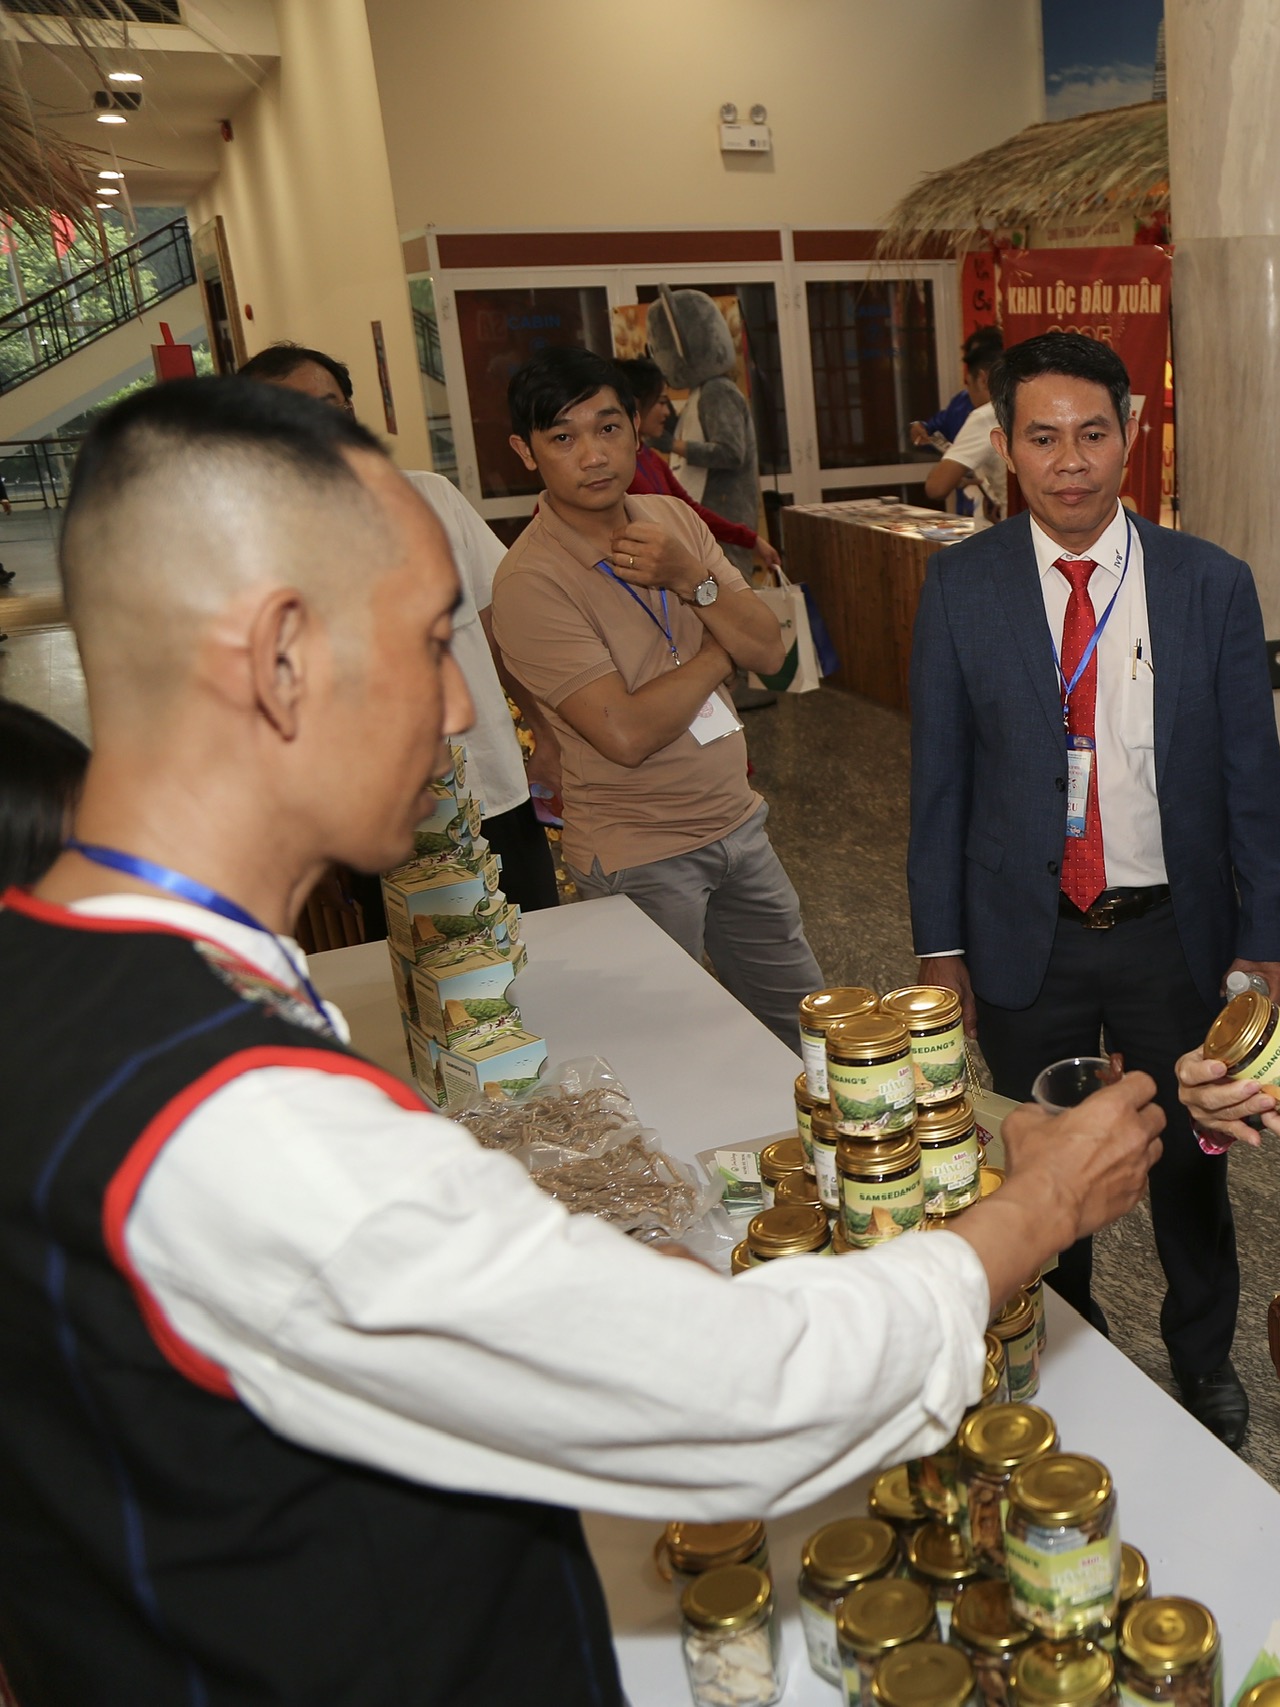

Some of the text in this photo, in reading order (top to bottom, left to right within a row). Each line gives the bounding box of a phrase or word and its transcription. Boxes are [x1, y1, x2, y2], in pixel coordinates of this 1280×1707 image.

[1008, 286, 1042, 314] KHAI
[1046, 279, 1076, 320] LỘC
[1081, 279, 1113, 314] ĐẦU
[1117, 276, 1162, 314] XUÂN
